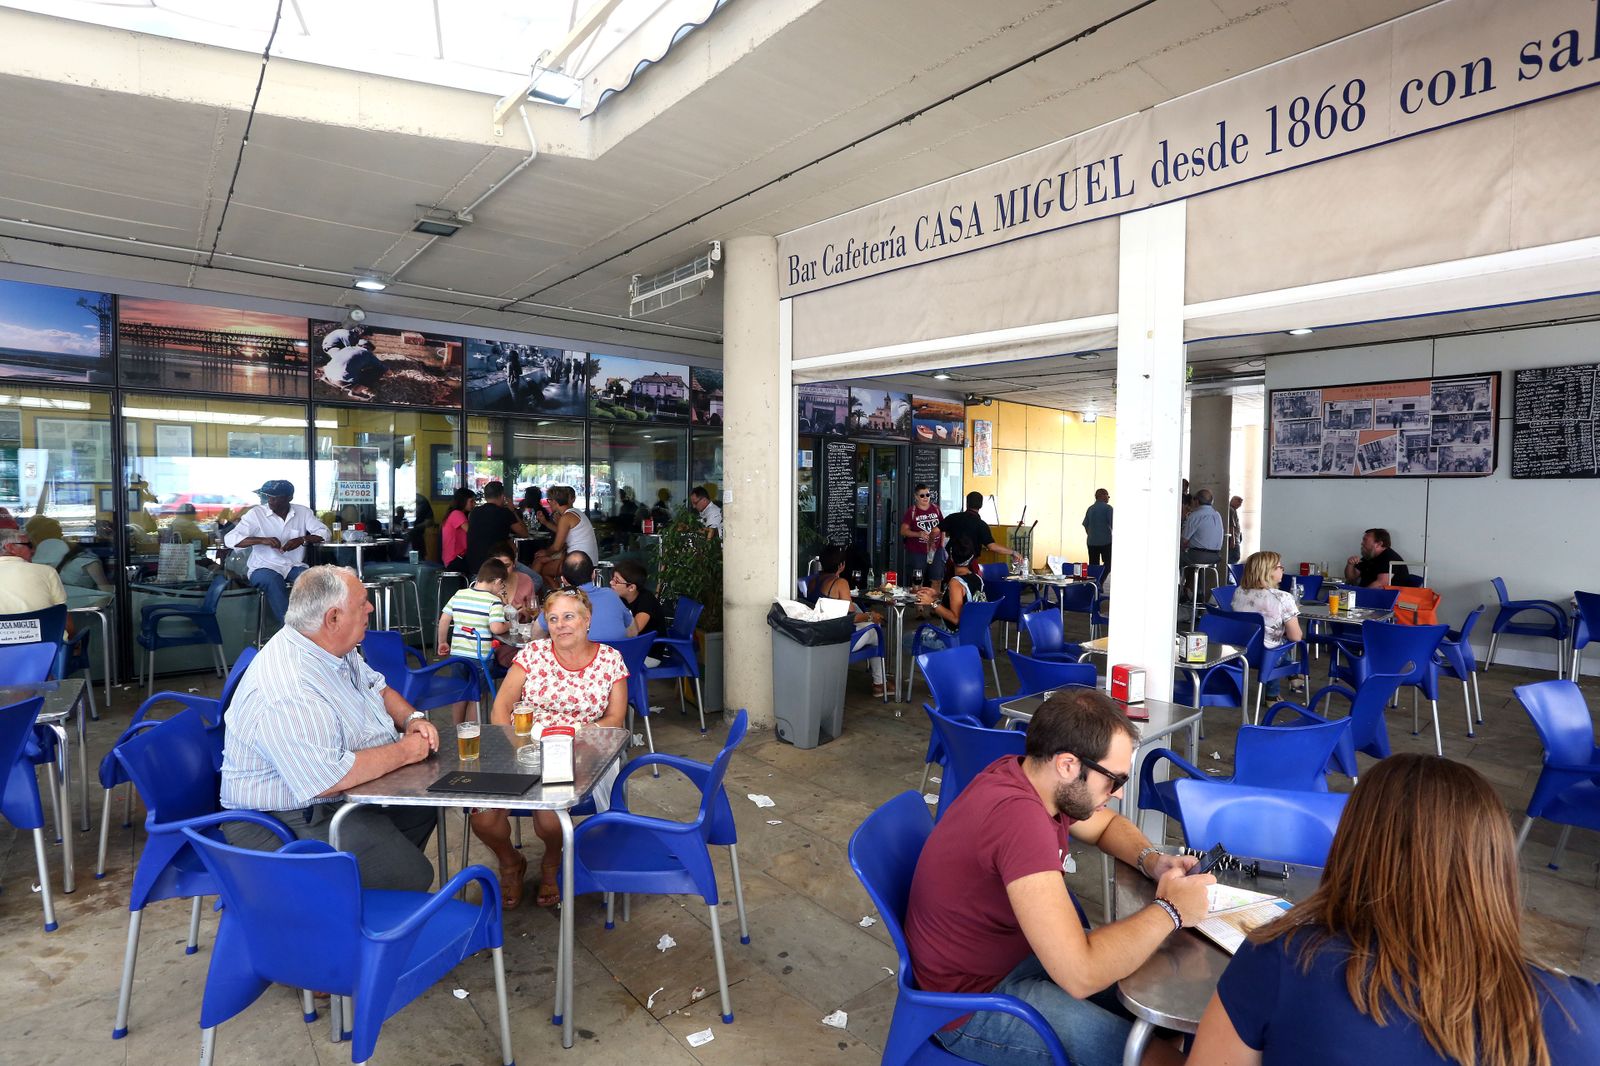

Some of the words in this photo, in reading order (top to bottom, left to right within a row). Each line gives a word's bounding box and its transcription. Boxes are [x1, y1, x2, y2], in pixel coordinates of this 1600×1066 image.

[788, 254, 816, 286] Bar
[822, 226, 907, 277] Cafetería
[914, 201, 985, 252] CASA
[993, 154, 1135, 232] MIGUEL
[1151, 120, 1249, 188] desde
[1265, 79, 1366, 156] 1868
[1399, 56, 1497, 115] con
[13, 621, 38, 629] MIGUEL
